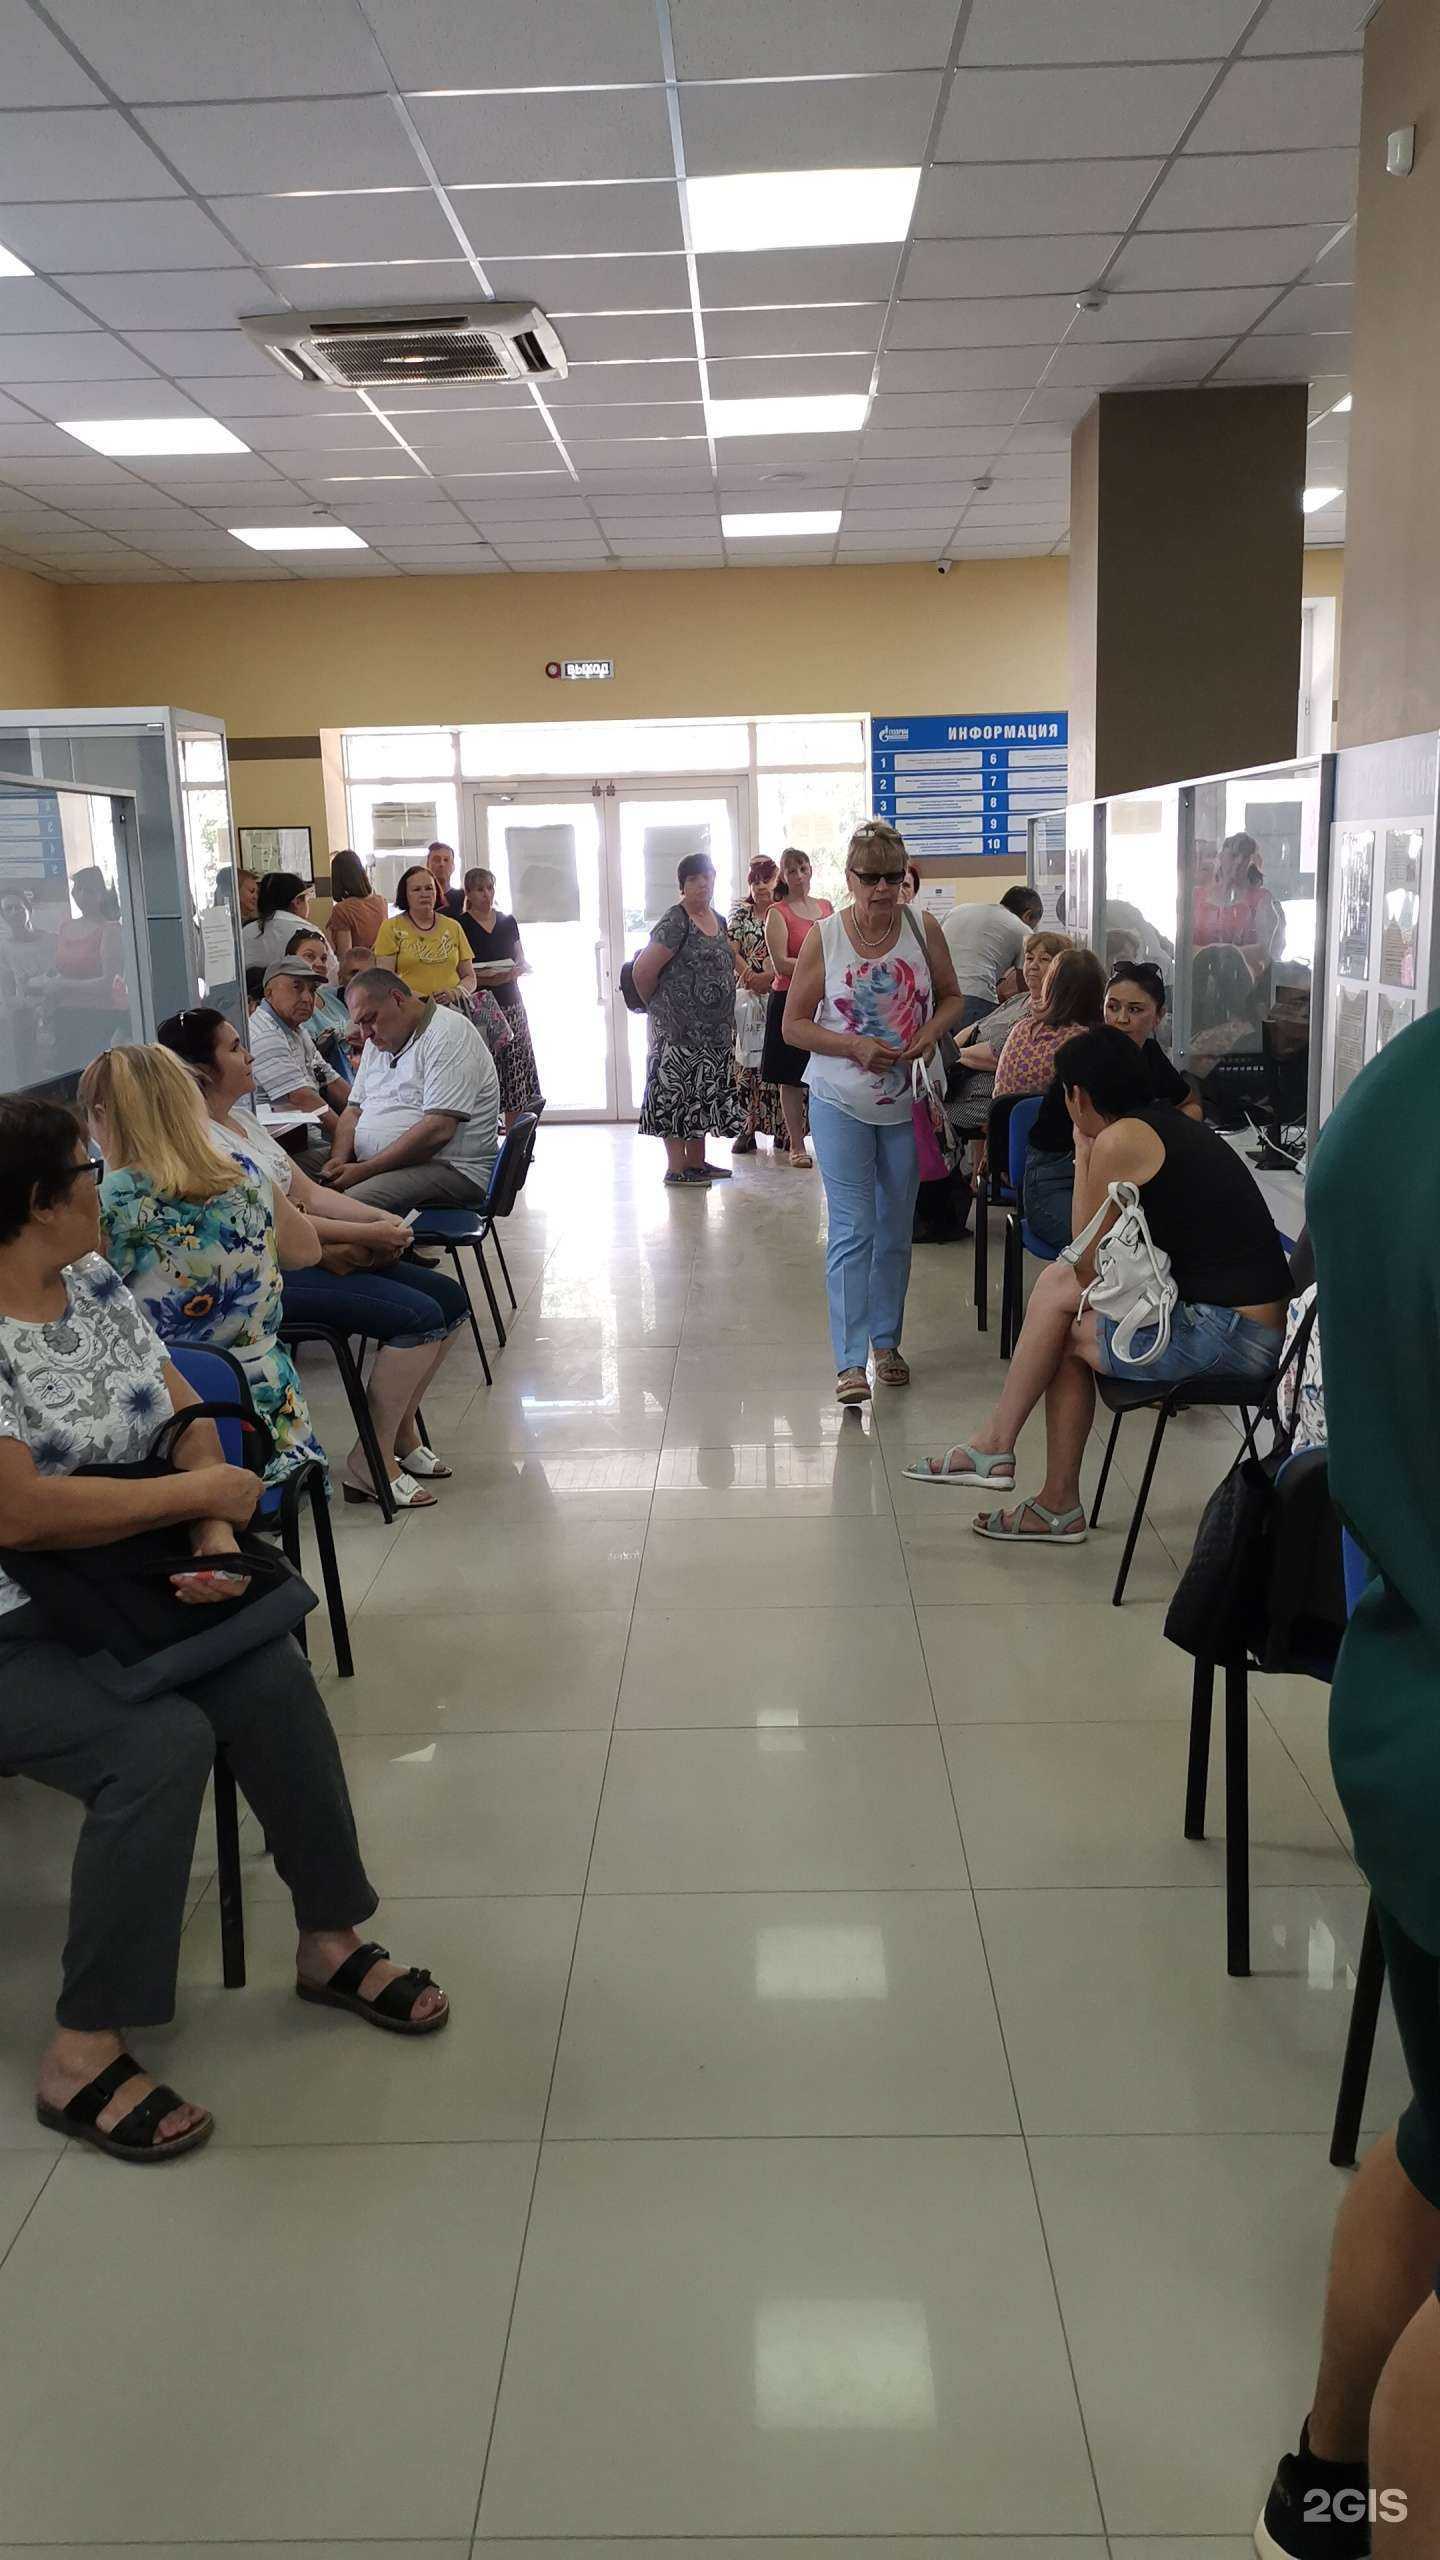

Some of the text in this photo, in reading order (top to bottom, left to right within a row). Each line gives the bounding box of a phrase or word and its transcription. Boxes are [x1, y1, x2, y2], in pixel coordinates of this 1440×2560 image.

[567, 663, 609, 676] ВЫХОД
[948, 723, 1058, 742] ИНФОРМАЦИЯ
[880, 758, 887, 768] 1
[990, 753, 997, 764] 6
[880, 780, 887, 791] 2
[990, 775, 997, 787] 7
[880, 801, 887, 812] 3
[990, 797, 997, 808] 8
[990, 818, 997, 830] 9
[987, 838, 1000, 849] 10
